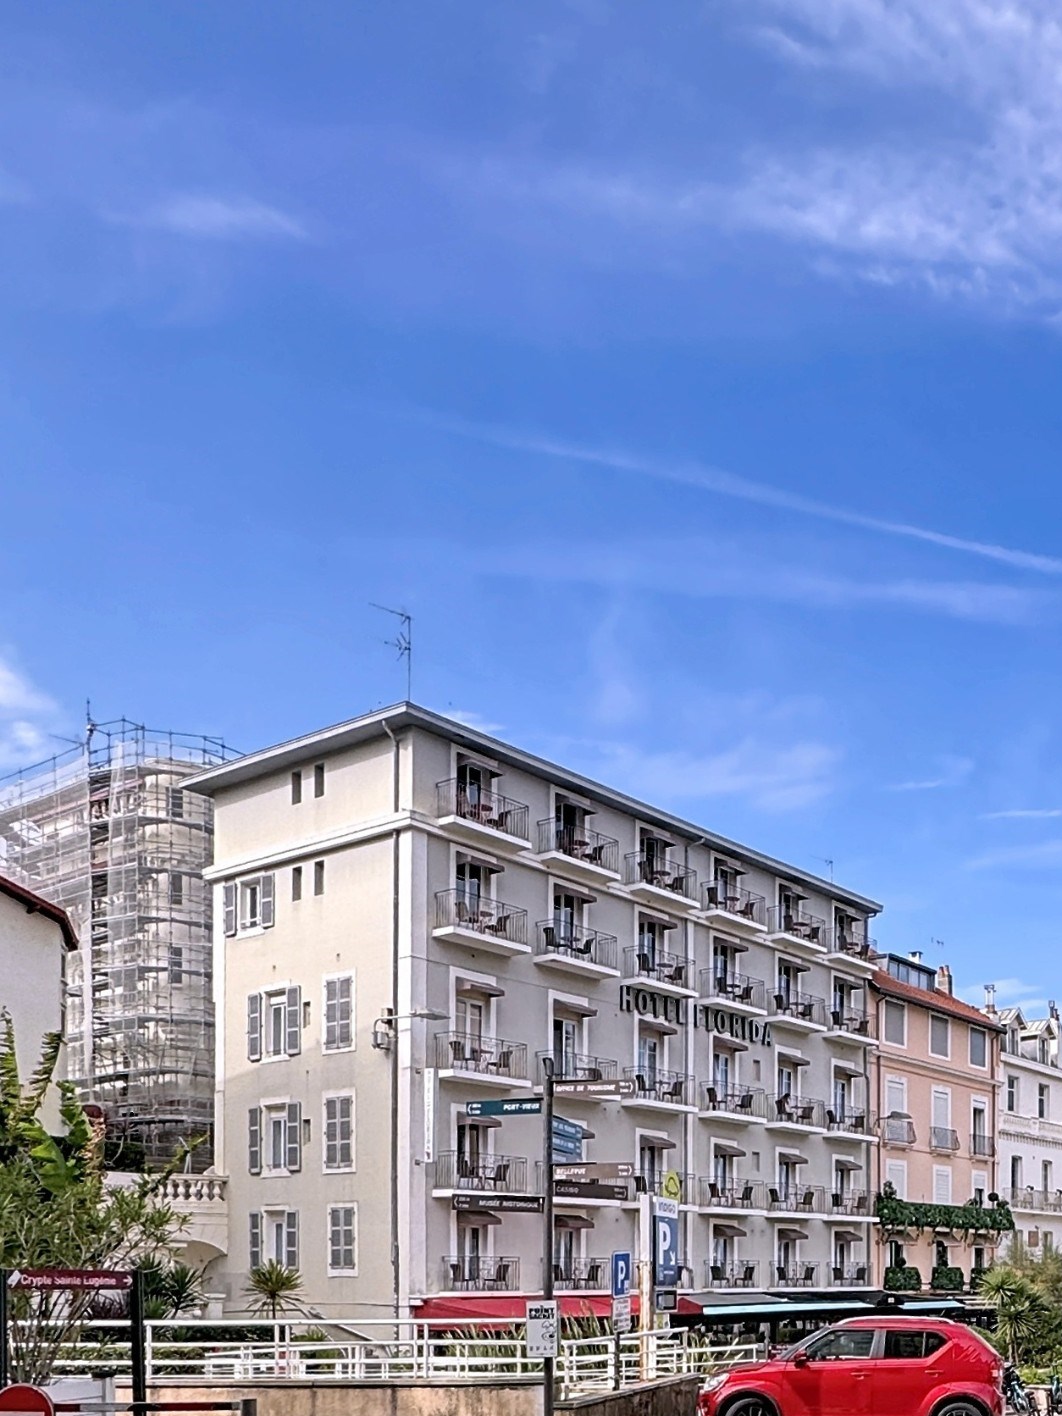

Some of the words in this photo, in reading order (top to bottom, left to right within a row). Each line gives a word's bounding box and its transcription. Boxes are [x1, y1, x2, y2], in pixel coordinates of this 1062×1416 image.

[620, 985, 686, 1024] HOTEL
[694, 1004, 772, 1047] FLORIDA
[556, 1167, 586, 1175] BELLEVUE
[658, 1221, 671, 1265] P
[21, 1274, 52, 1287] Crypte
[54, 1275, 81, 1285] Sainte
[83, 1275, 117, 1287] Eugénie
[618, 1260, 626, 1289] P
[529, 1304, 554, 1313] POINT
